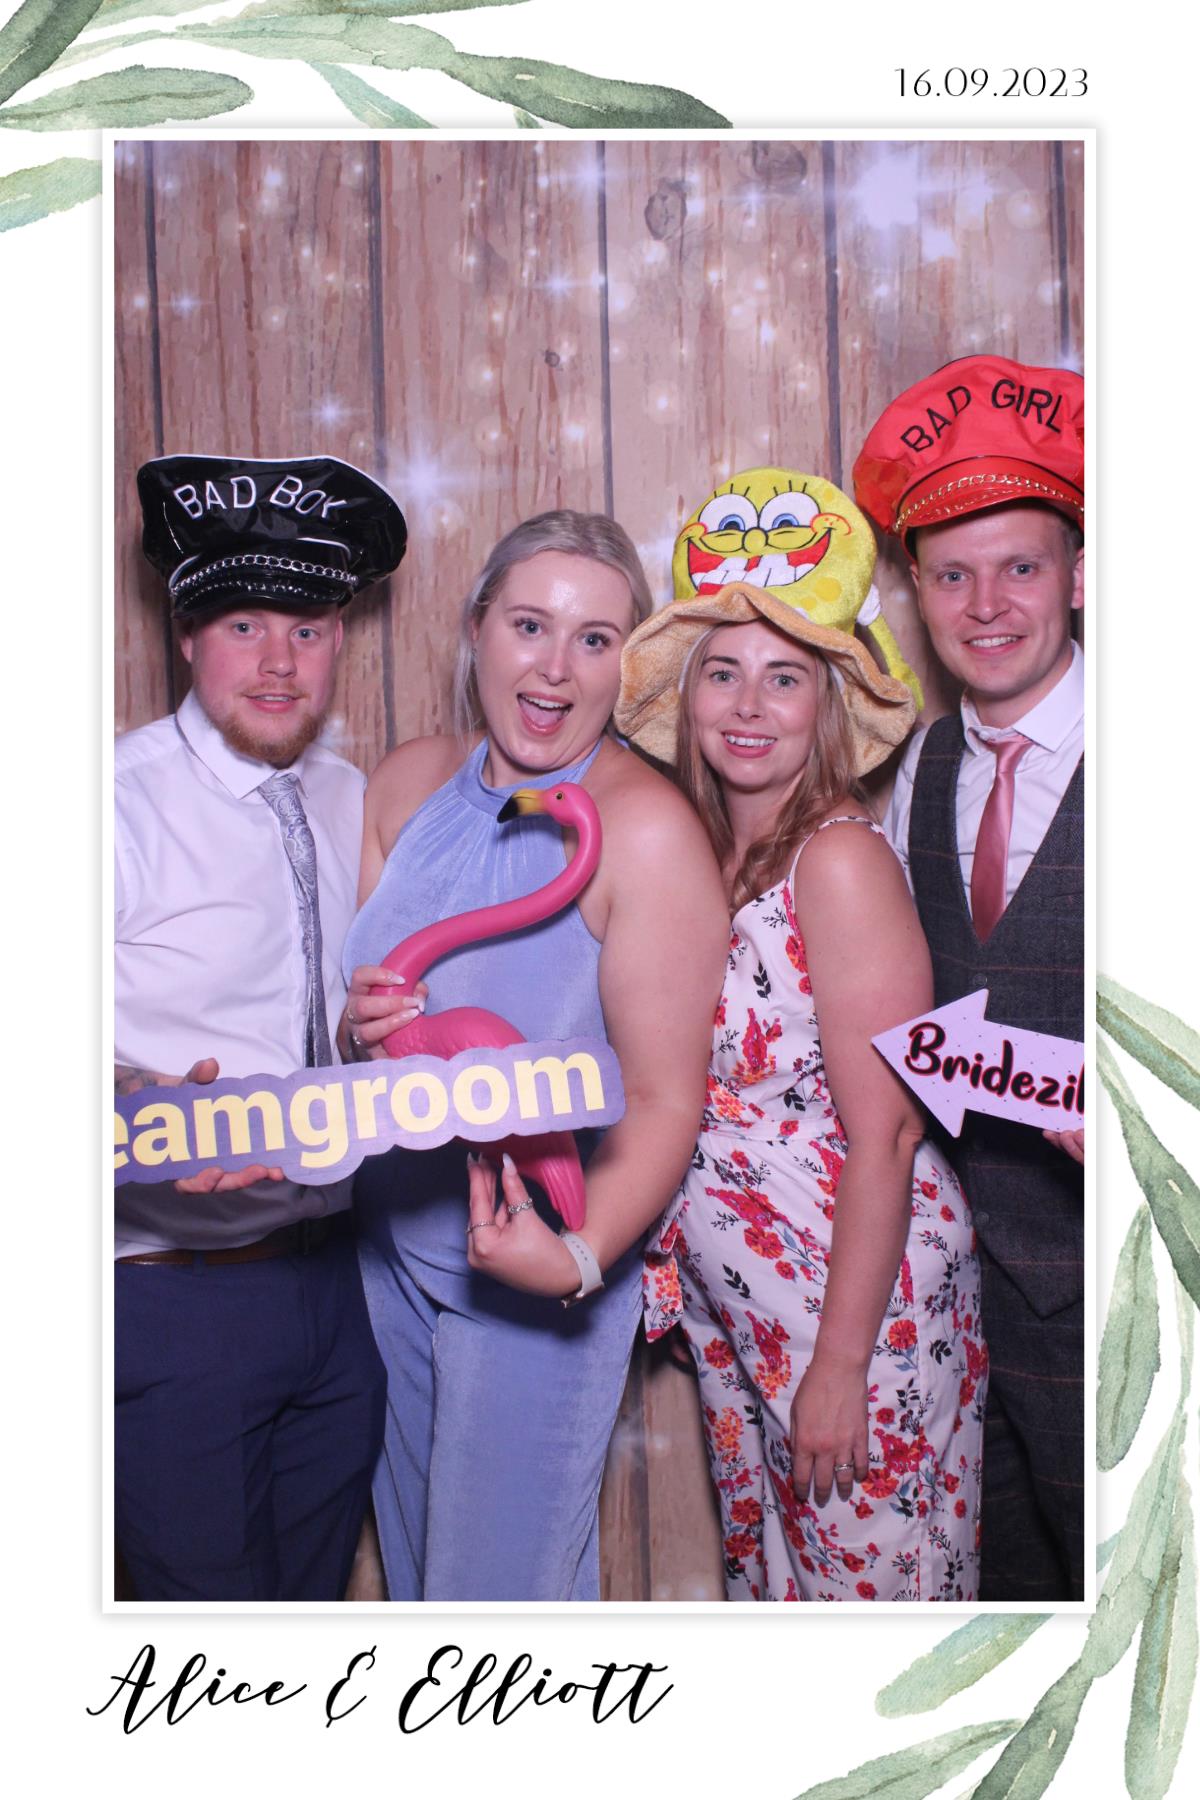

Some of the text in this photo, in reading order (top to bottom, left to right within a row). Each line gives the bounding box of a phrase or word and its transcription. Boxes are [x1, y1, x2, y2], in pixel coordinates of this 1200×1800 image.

[900, 379, 1063, 453] BAD GIRL
[173, 474, 347, 520] BAD BOY
[114, 1052, 606, 1169] amgroom
